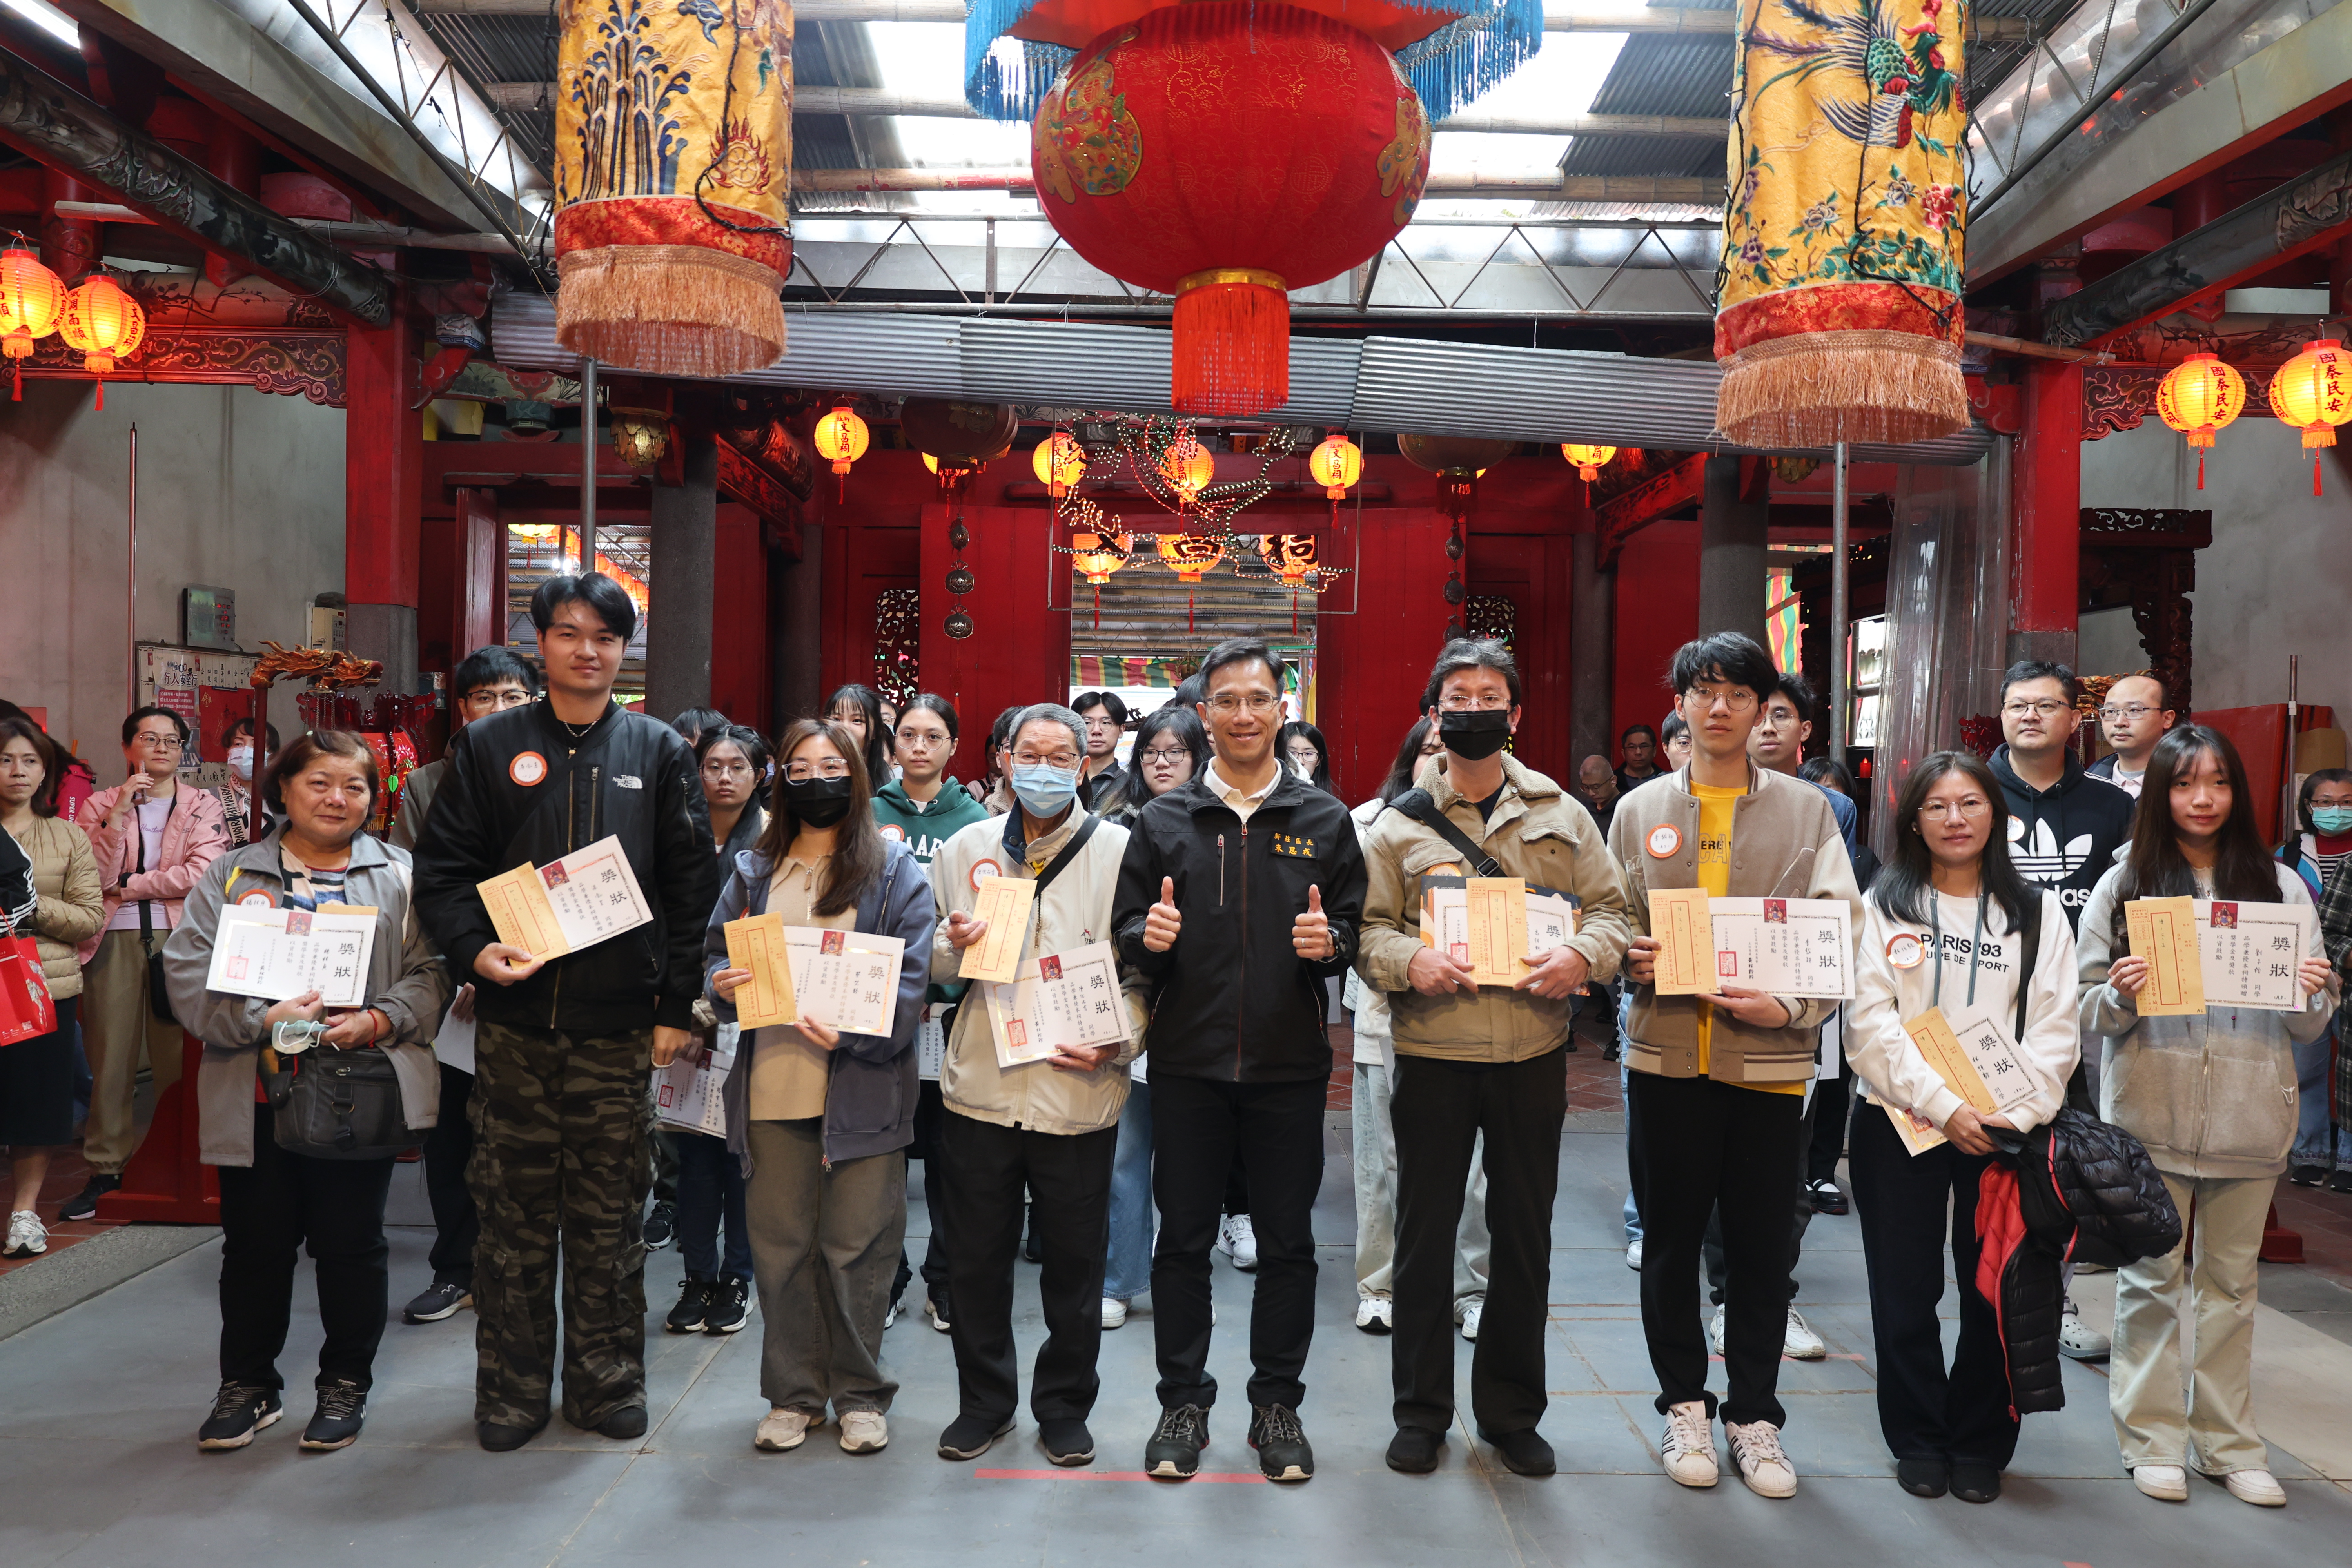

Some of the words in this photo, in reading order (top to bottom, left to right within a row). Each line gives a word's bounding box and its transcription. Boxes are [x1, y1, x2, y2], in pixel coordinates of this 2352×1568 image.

[2210, 366, 2230, 421] 國泰民安
[2319, 352, 2345, 413] 國泰民安
[839, 422, 850, 453] 文昌祠
[1331, 448, 1342, 480] 文昌祠
[164, 672, 198, 686] 行人安全行
[1274, 833, 1314, 846] 新莊區長
[1275, 843, 1312, 857] 朱思戎
[601, 868, 627, 905] 獎狀
[333, 942, 355, 978] 獎狀
[1793, 929, 1802, 987] 品學兼優本祠特頒贈
[1818, 930, 1837, 969] 獎狀
[1954, 955, 1966, 965] DE
[2228, 934, 2236, 975] 獎學金及獎狀
[2240, 935, 2250, 996] 品學兼優本祠特頒贈
[2269, 936, 2292, 978] 獎狀
[864, 965, 885, 1004] 獎狀
[1050, 987, 1060, 1011] 以資鼓勵
[1090, 975, 1111, 1014] 獎狀
[1808, 975, 1814, 988] 同學
[2254, 984, 2261, 998] 同學
[1060, 984, 1073, 1022] 獎學金及獎狀
[1070, 982, 1086, 1039] 品學兼優本祠特頒贈
[1979, 1034, 2014, 1075] 獎狀
[1994, 1087, 2005, 1100] 同學
